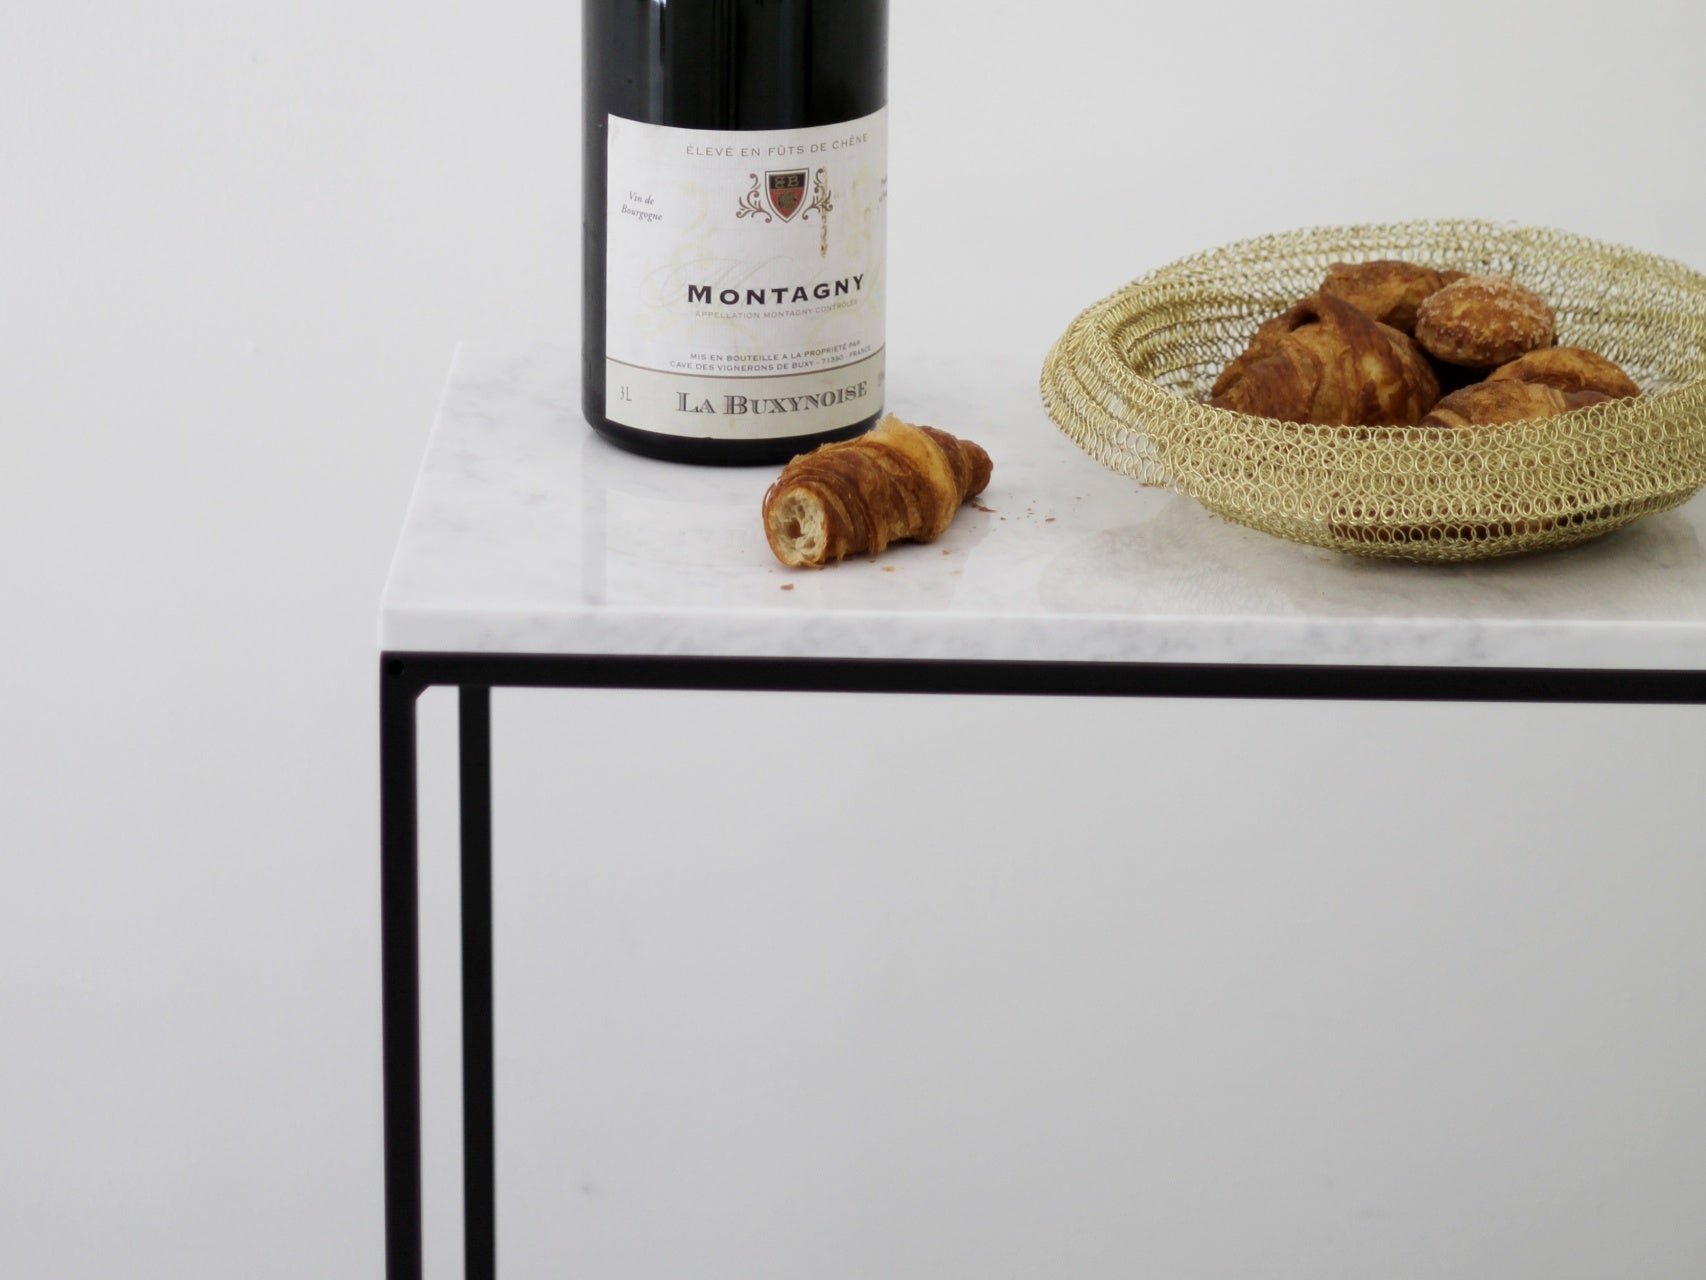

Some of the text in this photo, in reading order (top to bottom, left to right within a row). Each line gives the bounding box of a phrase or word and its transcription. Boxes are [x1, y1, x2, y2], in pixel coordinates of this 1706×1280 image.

[741, 147, 761, 157] EN
[768, 144, 805, 156] FÛTS
[810, 142, 827, 153] DE
[832, 133, 868, 150] CHÊNE
[629, 191, 654, 205] Vin de
[621, 203, 663, 222] Bourgogne
[688, 273, 864, 305] MONTAGNY
[695, 309, 760, 320] APPELLATION
[763, 307, 813, 320] MONTAGNY
[690, 352, 707, 360] MIS
[710, 353, 723, 361] EN
[726, 353, 779, 362] BOUTEILLE
[791, 351, 802, 359] LA
[669, 360, 693, 369] CAVE
[695, 362, 715, 371] DES
[717, 363, 774, 372] VIGNERONS
[777, 362, 789, 370] DE
[792, 360, 814, 370] BUXY
[676, 380, 868, 415] LA BUXYNOISE
